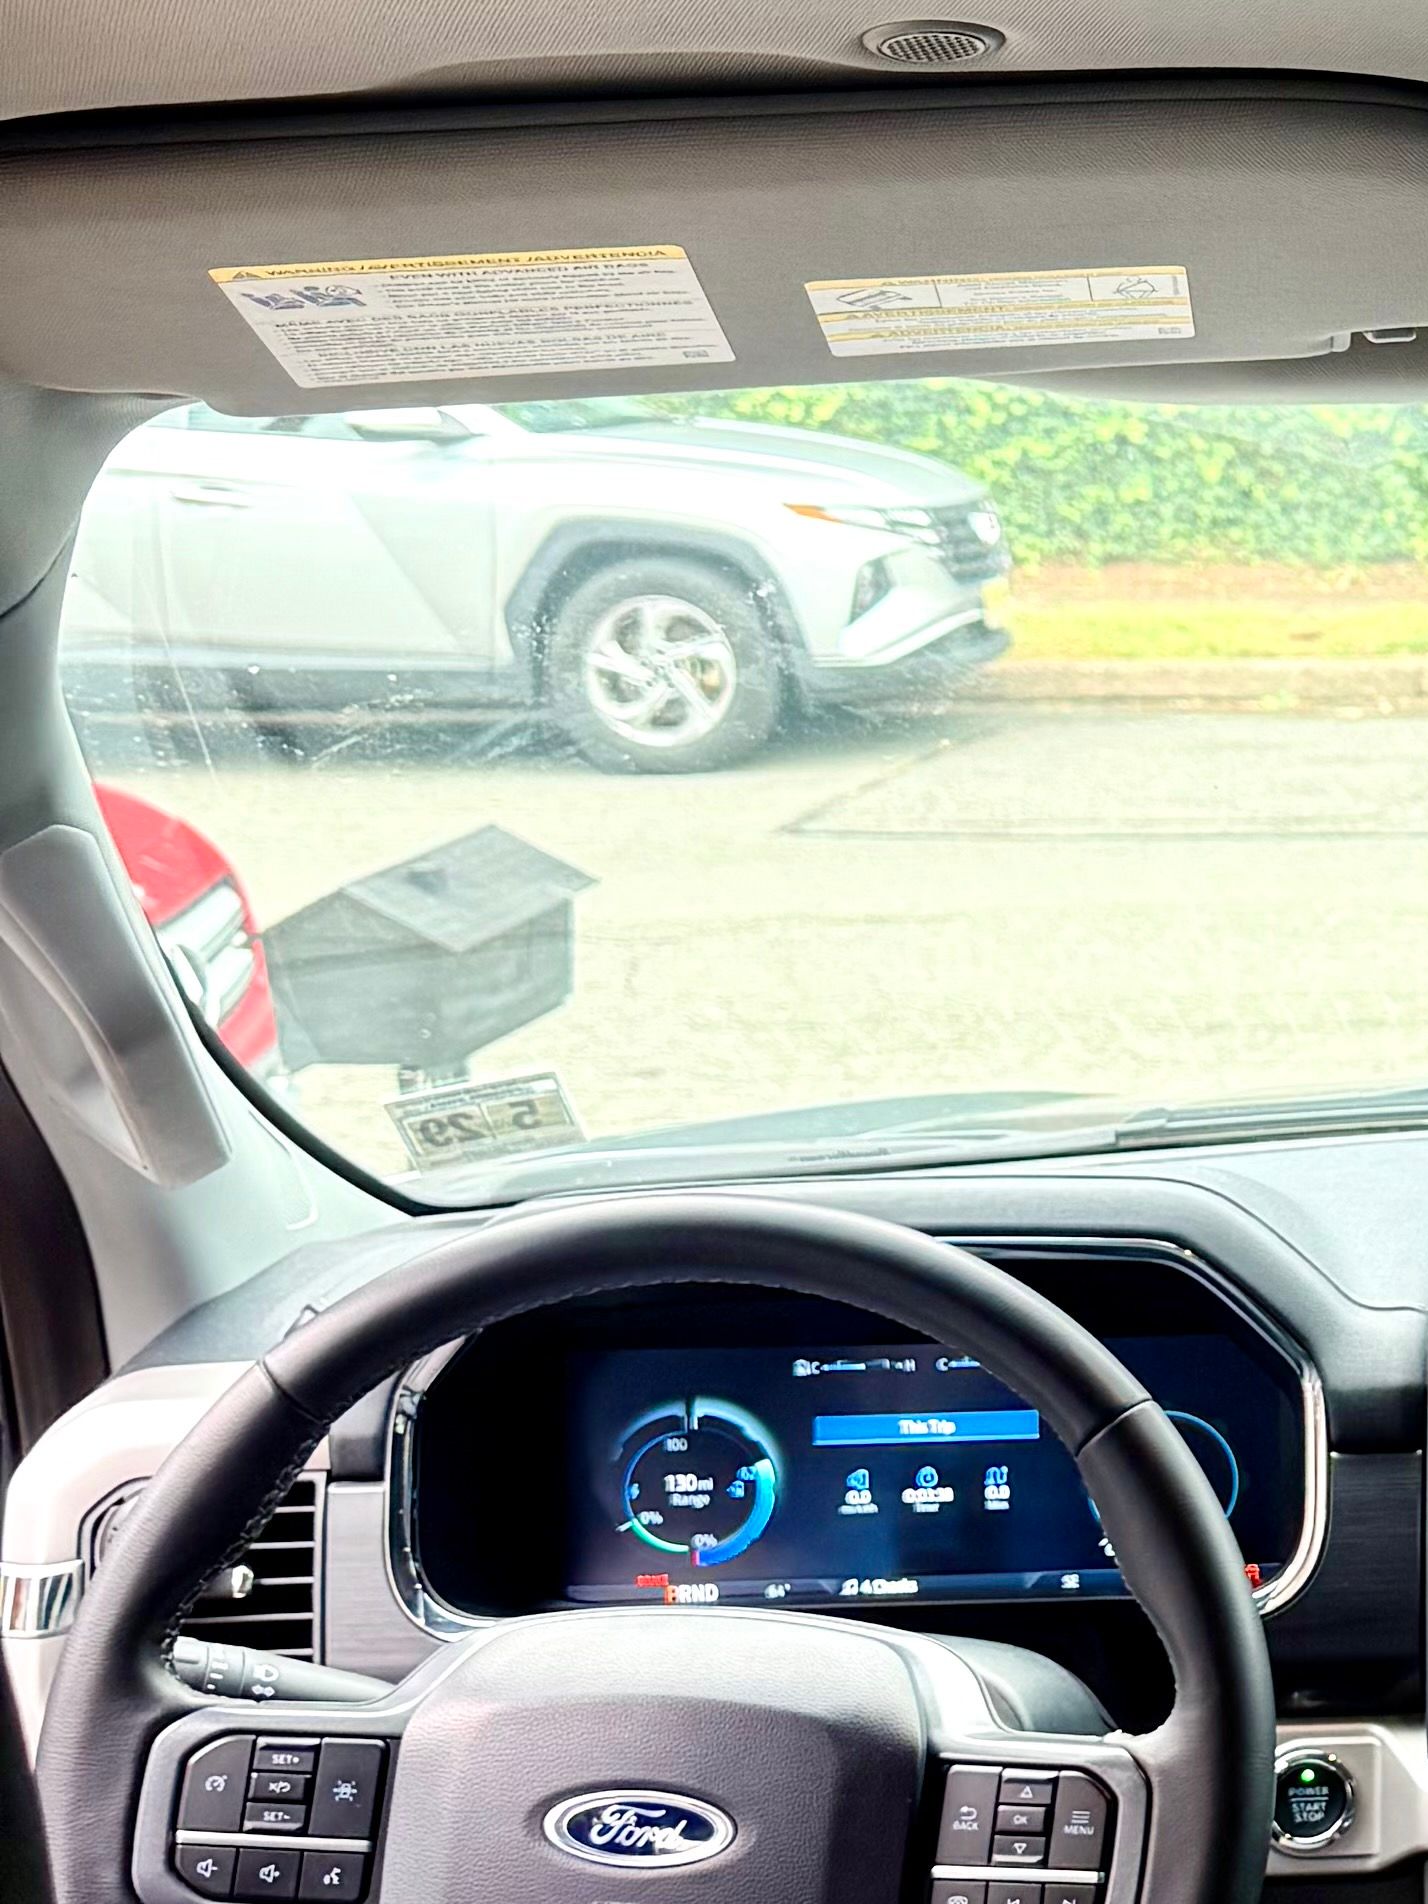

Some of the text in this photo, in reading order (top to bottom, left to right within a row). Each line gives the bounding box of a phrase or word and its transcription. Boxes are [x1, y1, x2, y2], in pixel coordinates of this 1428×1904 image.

[898, 1418, 957, 1436] This Trip
[664, 1437, 689, 1452] 100
[1287, 1786, 1330, 1797] POWER
[1291, 1801, 1327, 1813] START
[1012, 1814, 1028, 1825] OK
[1293, 1811, 1325, 1824] STOP
[589, 1803, 696, 1850] Ford
[952, 1820, 979, 1831] BACK
[1063, 1824, 1095, 1836] MENU
